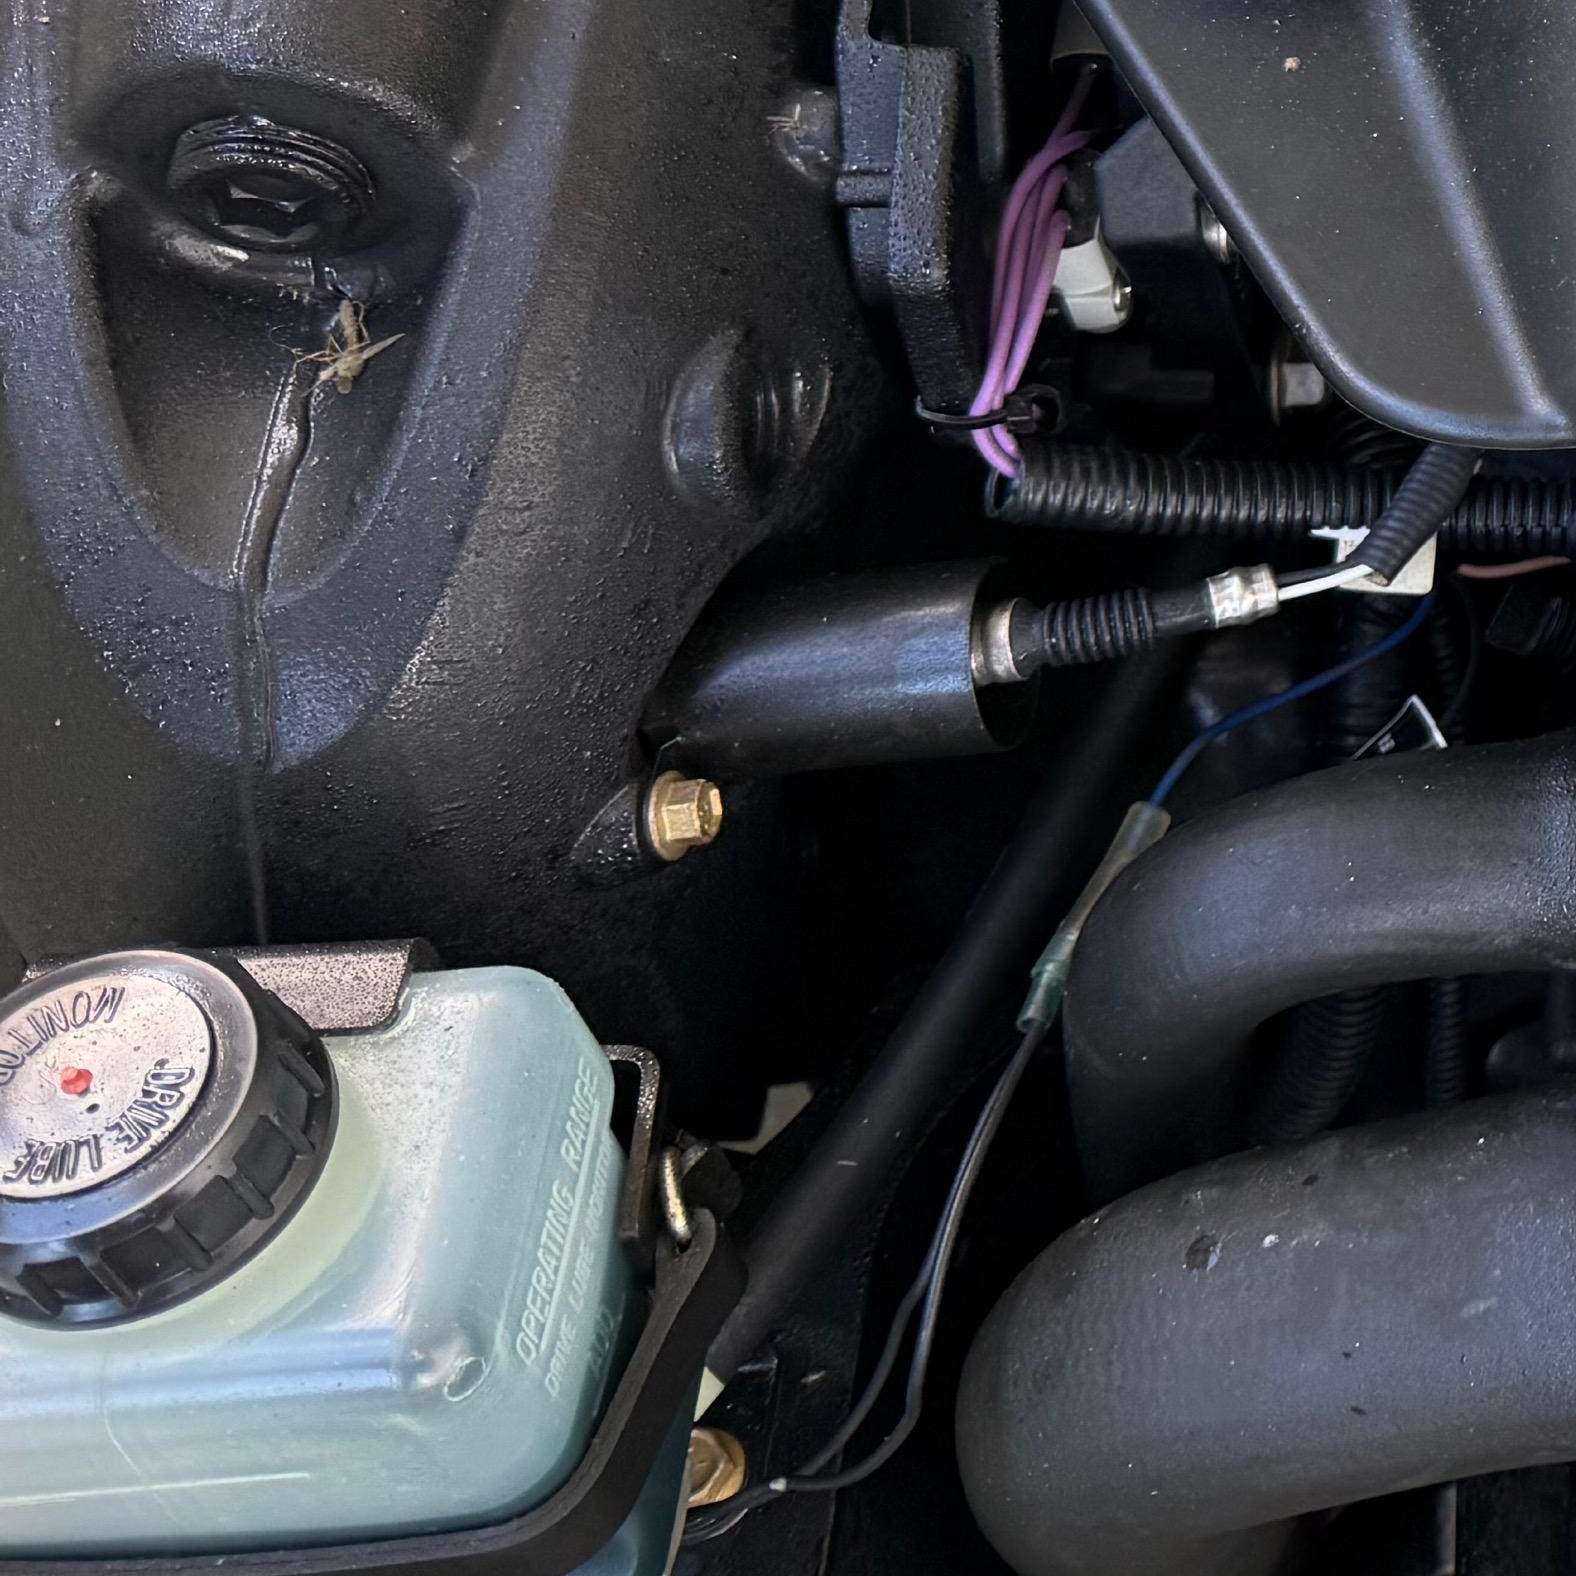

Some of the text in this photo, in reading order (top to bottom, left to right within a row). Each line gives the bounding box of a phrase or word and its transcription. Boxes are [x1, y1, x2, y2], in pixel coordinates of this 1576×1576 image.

[104, 1064, 196, 1154] DRIVE
[1, 1133, 103, 1186] LUBE
[514, 1055, 599, 1367] OPERATING RANGE
